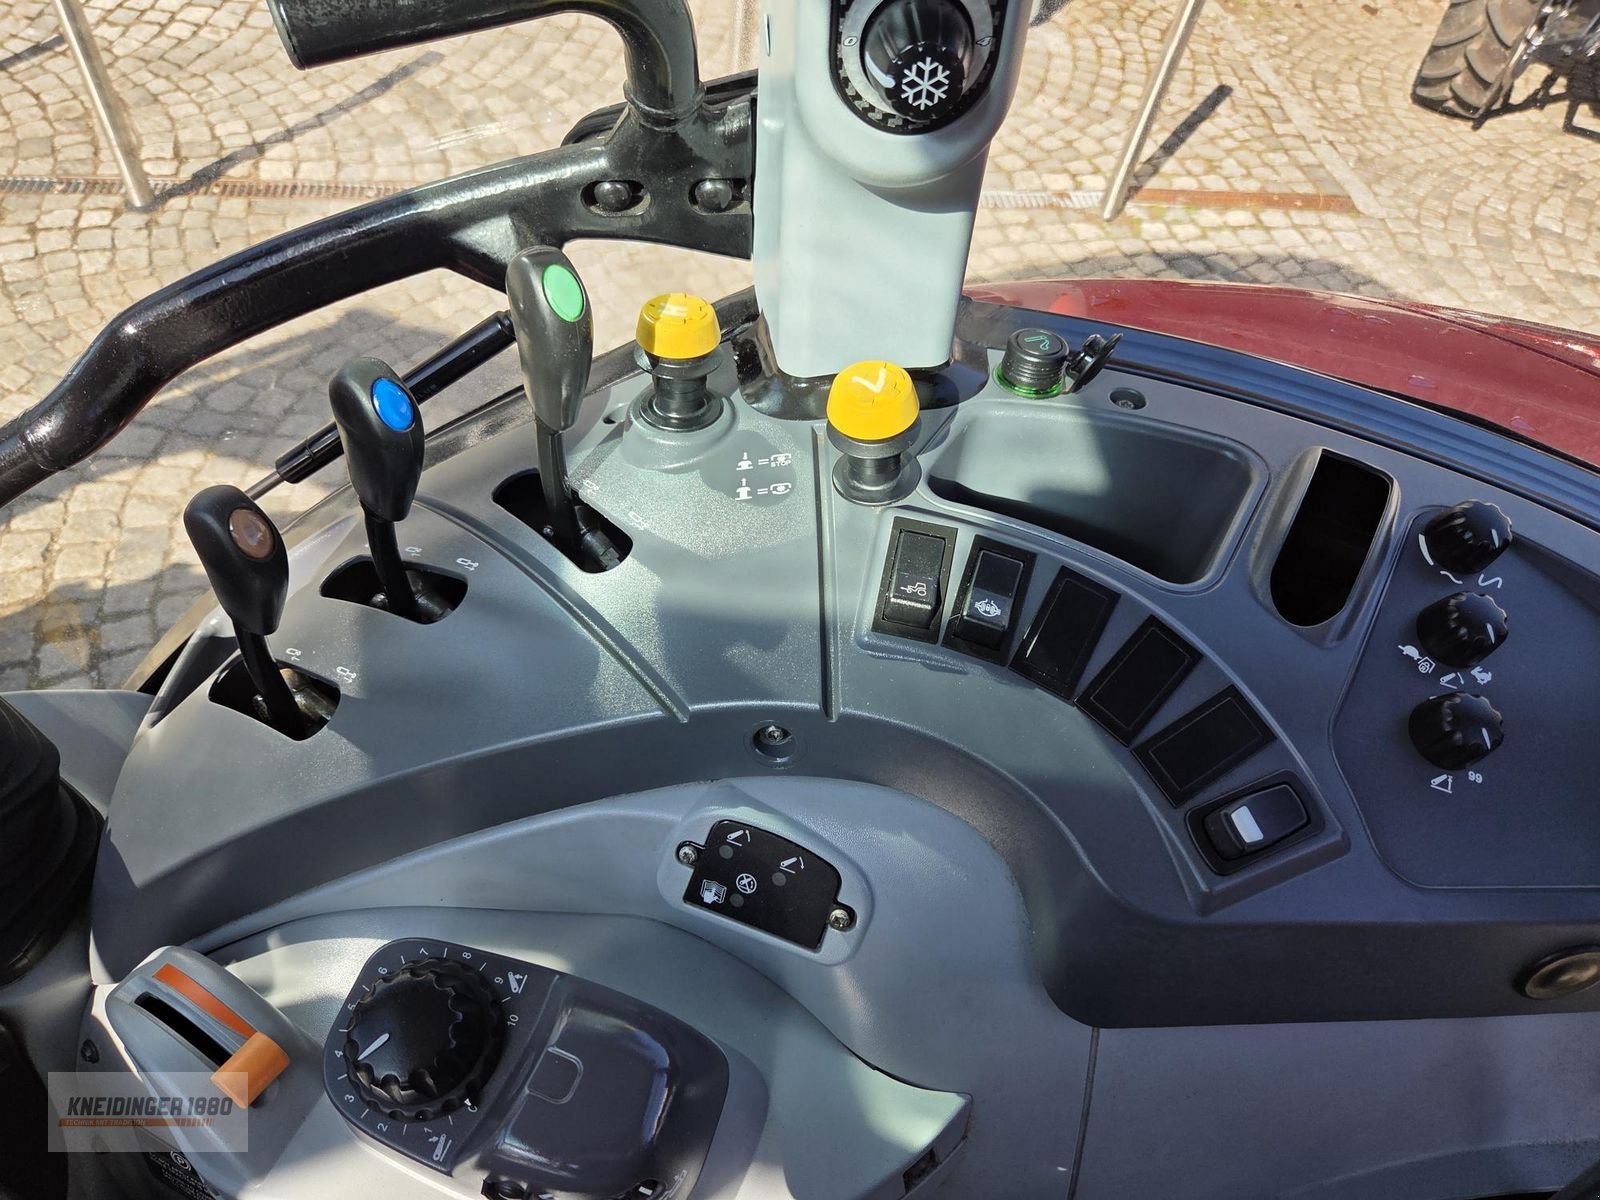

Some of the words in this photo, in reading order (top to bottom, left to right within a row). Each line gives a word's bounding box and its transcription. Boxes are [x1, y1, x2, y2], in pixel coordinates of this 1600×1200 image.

[770, 459, 792, 467] STOP
[420, 947, 429, 956] 7
[378, 966, 388, 975] 6
[494, 976, 504, 985] 9
[347, 1003, 356, 1011] 5
[507, 1014, 519, 1026] 10
[334, 1049, 344, 1058] 4
[344, 1094, 355, 1103] 3
[377, 1122, 389, 1132] 2
